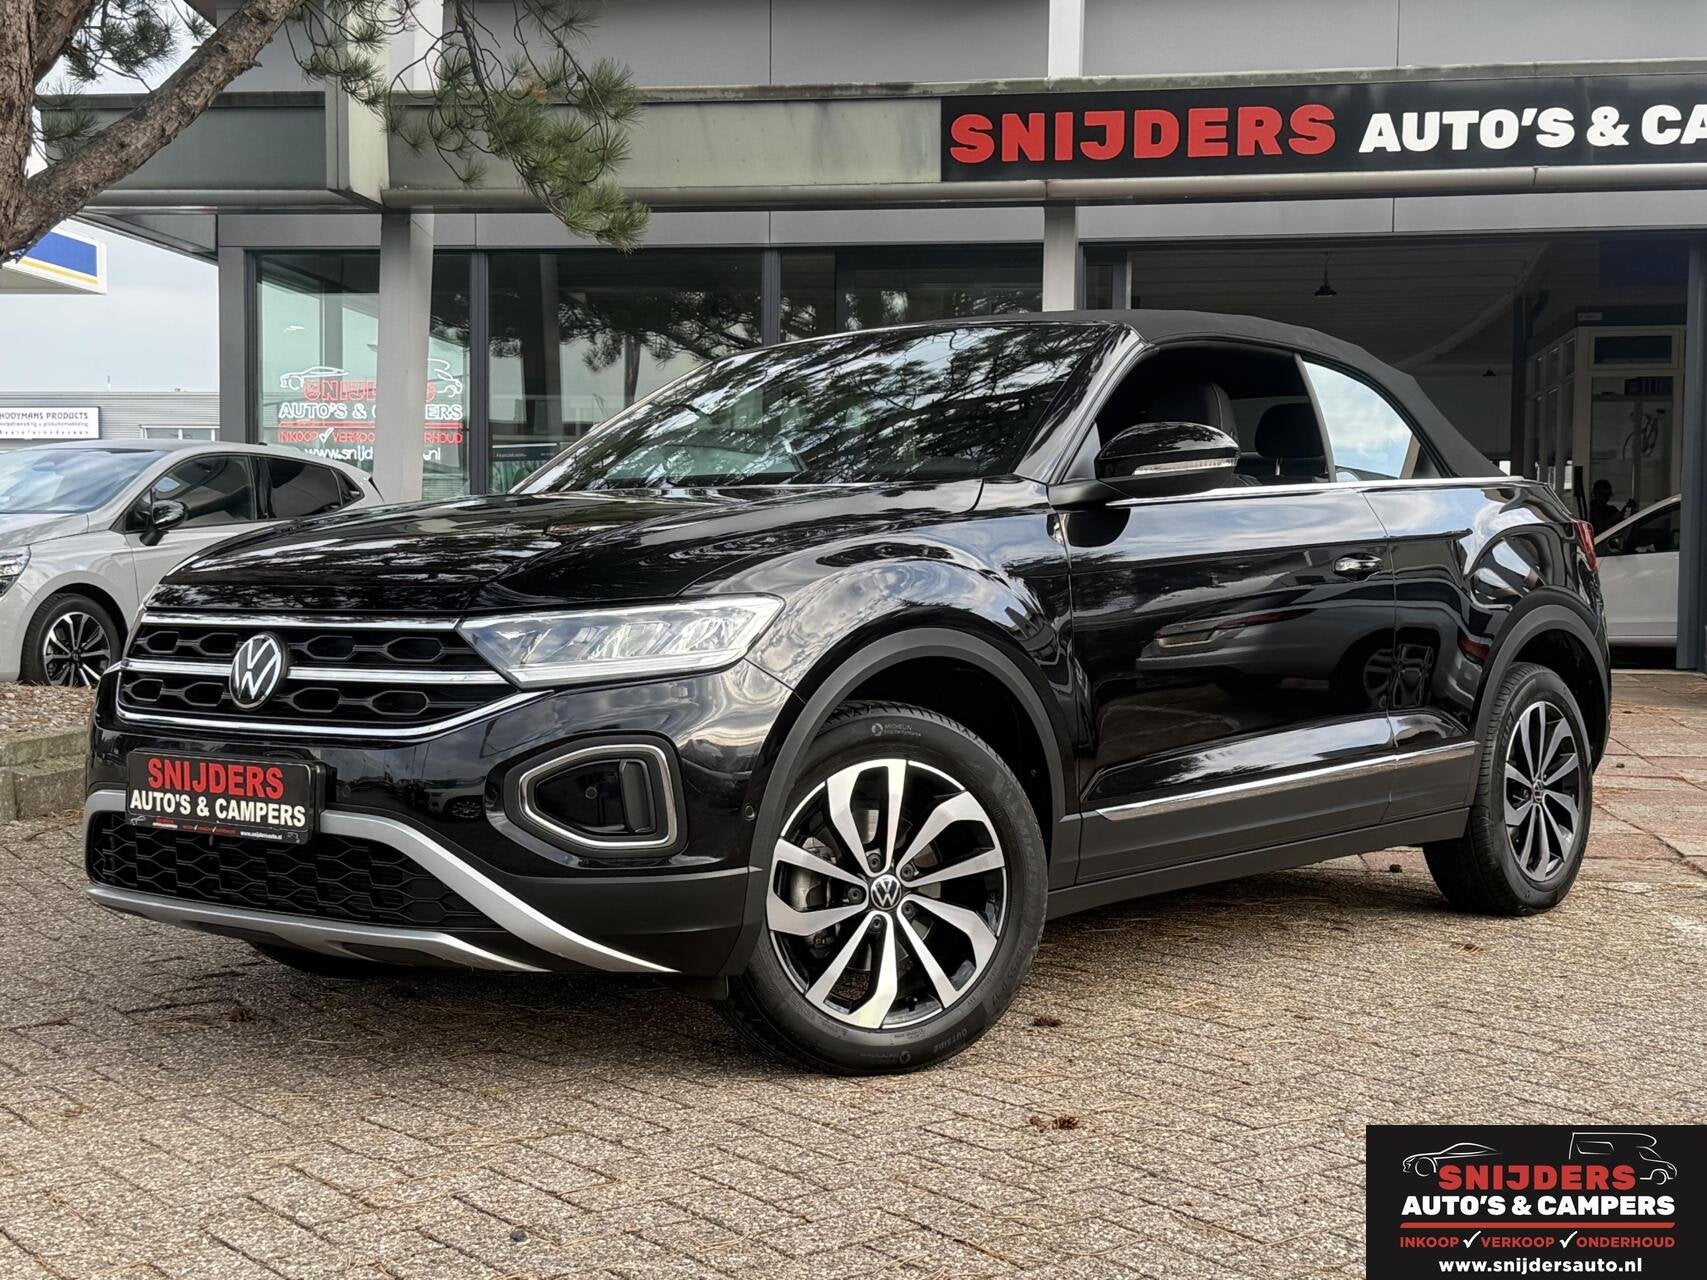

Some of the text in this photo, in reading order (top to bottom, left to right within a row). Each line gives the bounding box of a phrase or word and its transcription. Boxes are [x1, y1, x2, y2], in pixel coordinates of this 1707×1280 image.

[950, 105, 1336, 164] SNIJDERS
[1359, 107, 1575, 153] AUTO'S
[1587, 105, 1629, 147] &
[46, 412, 88, 420] PRODUCTS
[279, 402, 347, 419] AUTO'S
[352, 403, 367, 419] &
[279, 431, 318, 442] INKOOP
[333, 432, 376, 443] VERKOO
[148, 758, 283, 799] SNIJDERS
[130, 790, 305, 827] AUTO'S & CAMPERS
